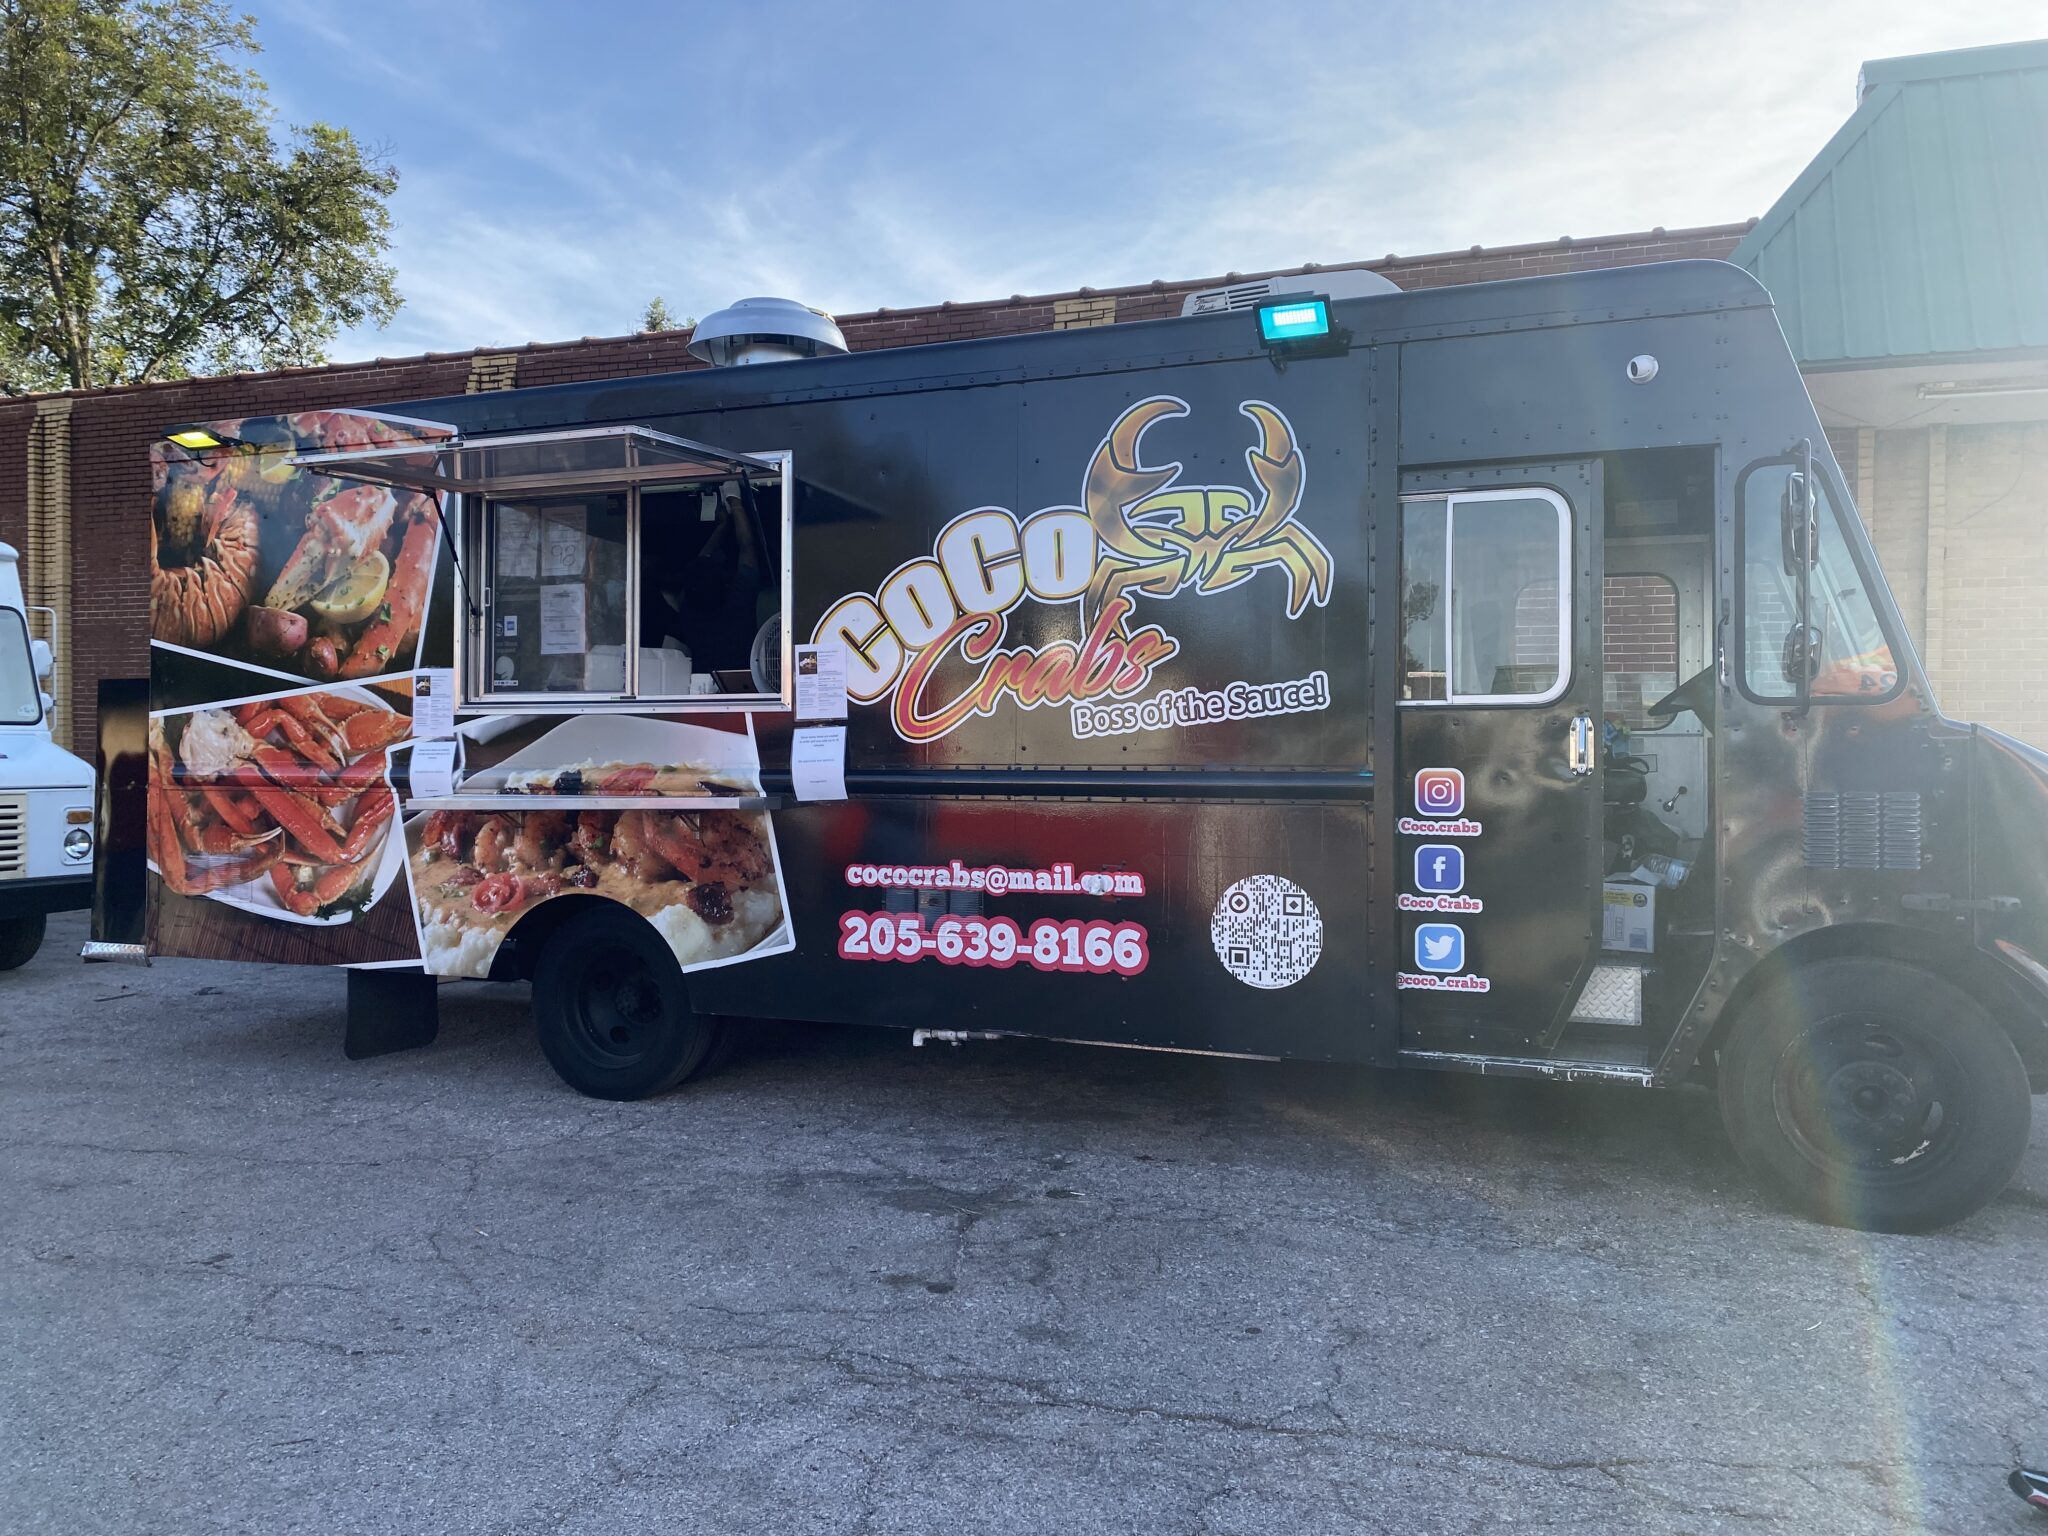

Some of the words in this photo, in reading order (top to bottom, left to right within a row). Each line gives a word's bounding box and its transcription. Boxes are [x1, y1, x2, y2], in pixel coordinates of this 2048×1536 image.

[551, 544, 577, 567] 98
[894, 598, 1178, 741] Crabs
[1074, 704, 1137, 735] Boss
[1141, 692, 1172, 726] of
[1175, 690, 1225, 722] the
[1229, 675, 1327, 717] Sauce!
[1400, 820, 1479, 833] Coco.crabs
[1400, 896, 1434, 908] Coco
[1437, 897, 1480, 910] Crabs
[843, 915, 1143, 969] 205-639-8166
